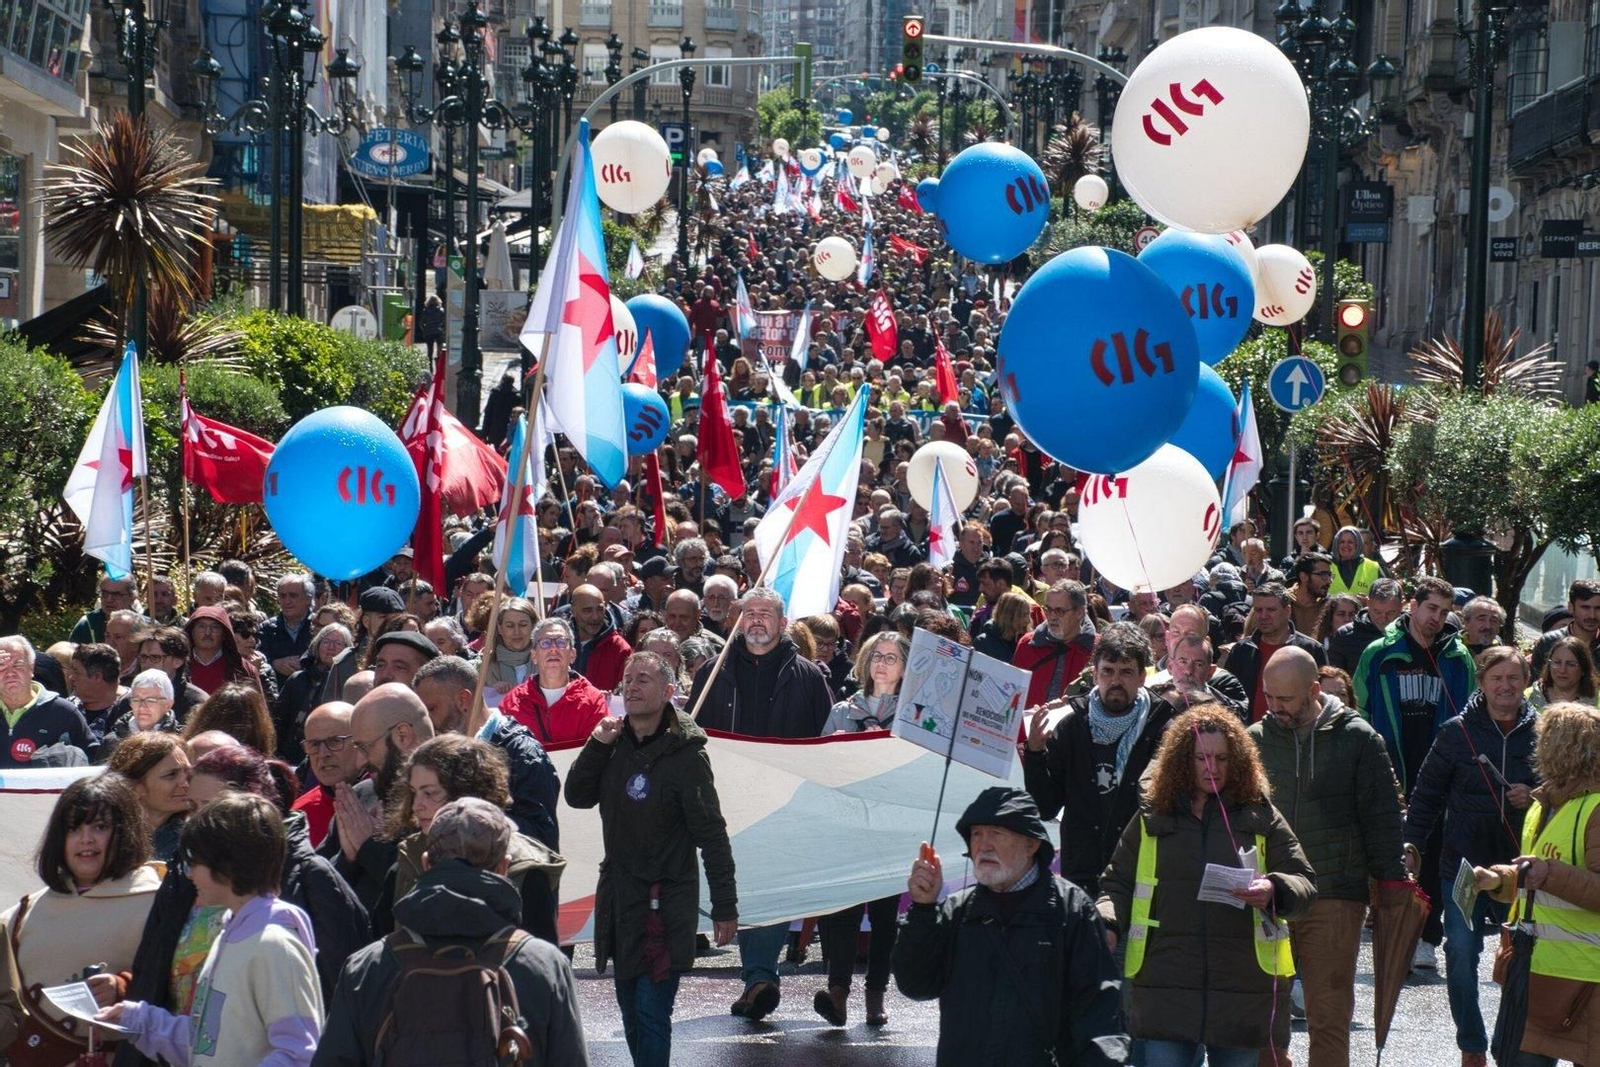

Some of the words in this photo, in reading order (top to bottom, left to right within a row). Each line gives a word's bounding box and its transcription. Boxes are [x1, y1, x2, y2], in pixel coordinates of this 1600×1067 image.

[1142, 78, 1225, 146] CIG
[665, 128, 684, 150] P
[602, 164, 631, 183] CIG
[1355, 190, 1381, 199] Ulloa
[1578, 242, 1600, 250] BER
[816, 252, 831, 265] CIG
[1295, 266, 1313, 294] CIG
[1181, 283, 1238, 319] CIG
[1261, 305, 1285, 318] CIG
[757, 342, 792, 357] Conv
[1091, 328, 1175, 387] CIG
[337, 466, 395, 506] CIG
[16, 743, 32, 752] CIG
[1542, 842, 1562, 859] CIG
